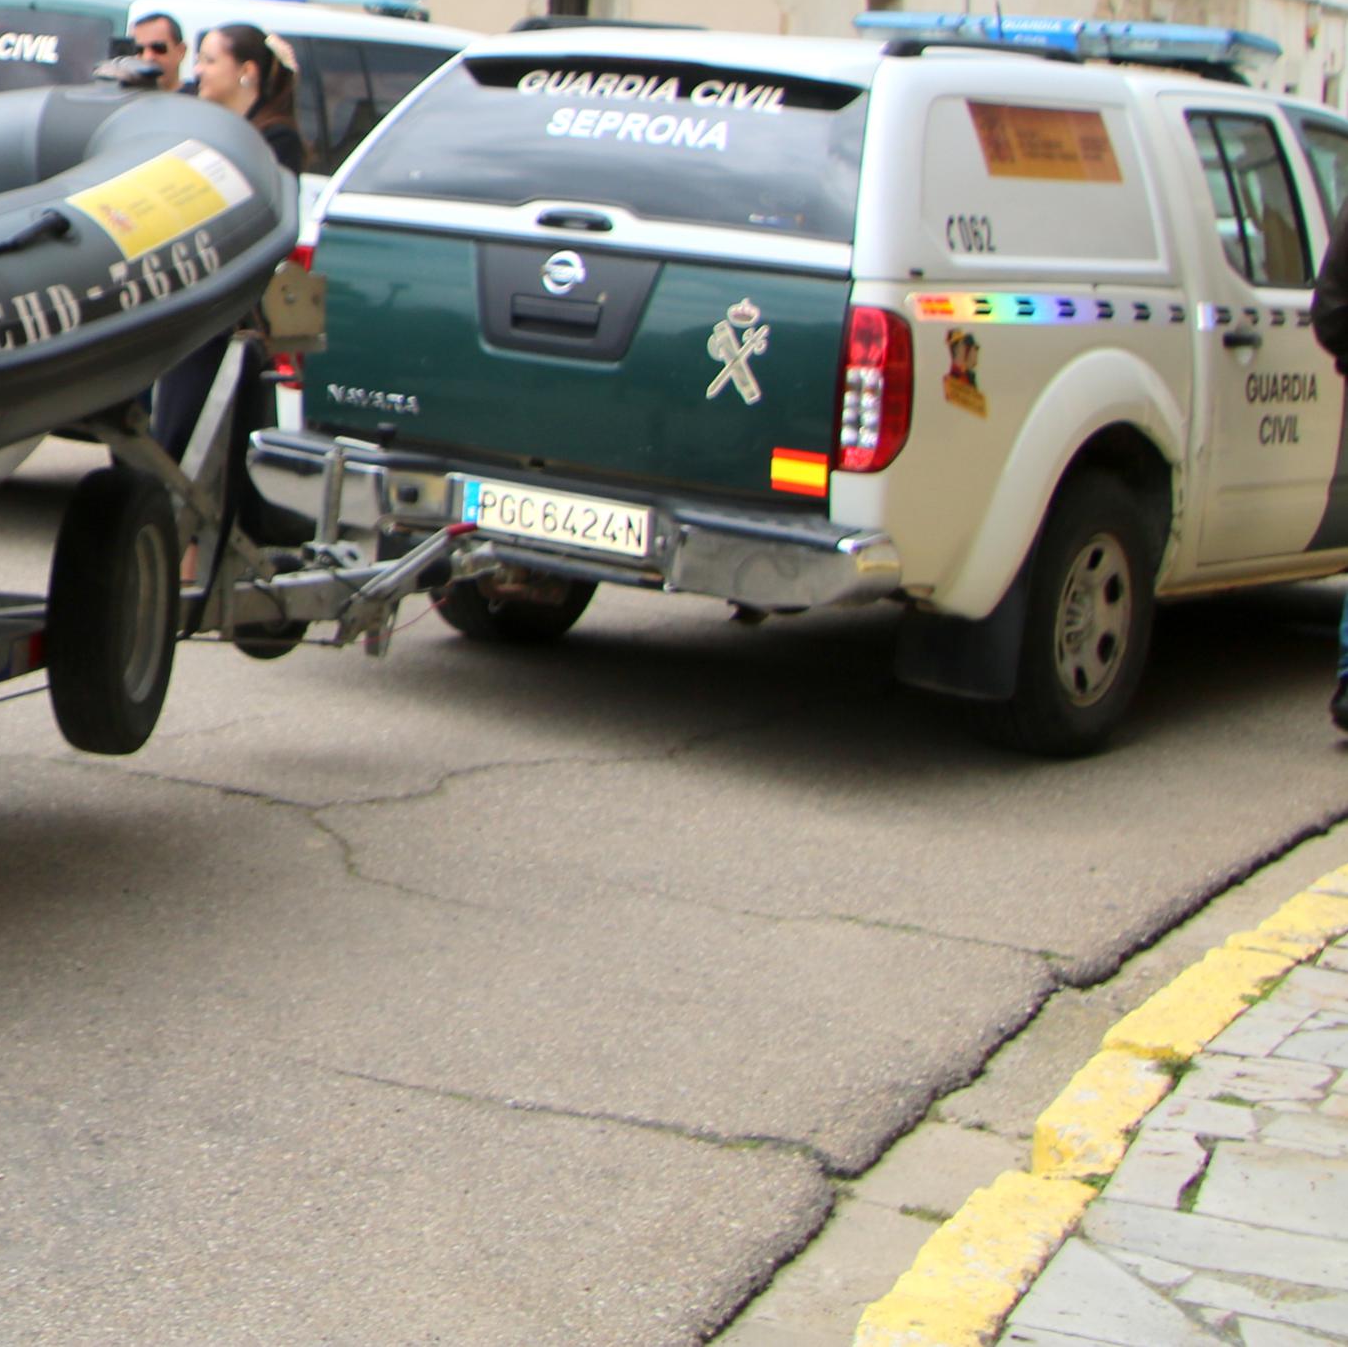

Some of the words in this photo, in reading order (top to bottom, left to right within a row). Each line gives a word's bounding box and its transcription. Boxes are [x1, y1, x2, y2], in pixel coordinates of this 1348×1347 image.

[516, 69, 681, 104] GUARDIA
[690, 79, 786, 114] CIVIL
[545, 107, 729, 151] SEPRONA
[1245, 372, 1318, 403] GUARDIA
[1258, 414, 1300, 446] CIVIL
